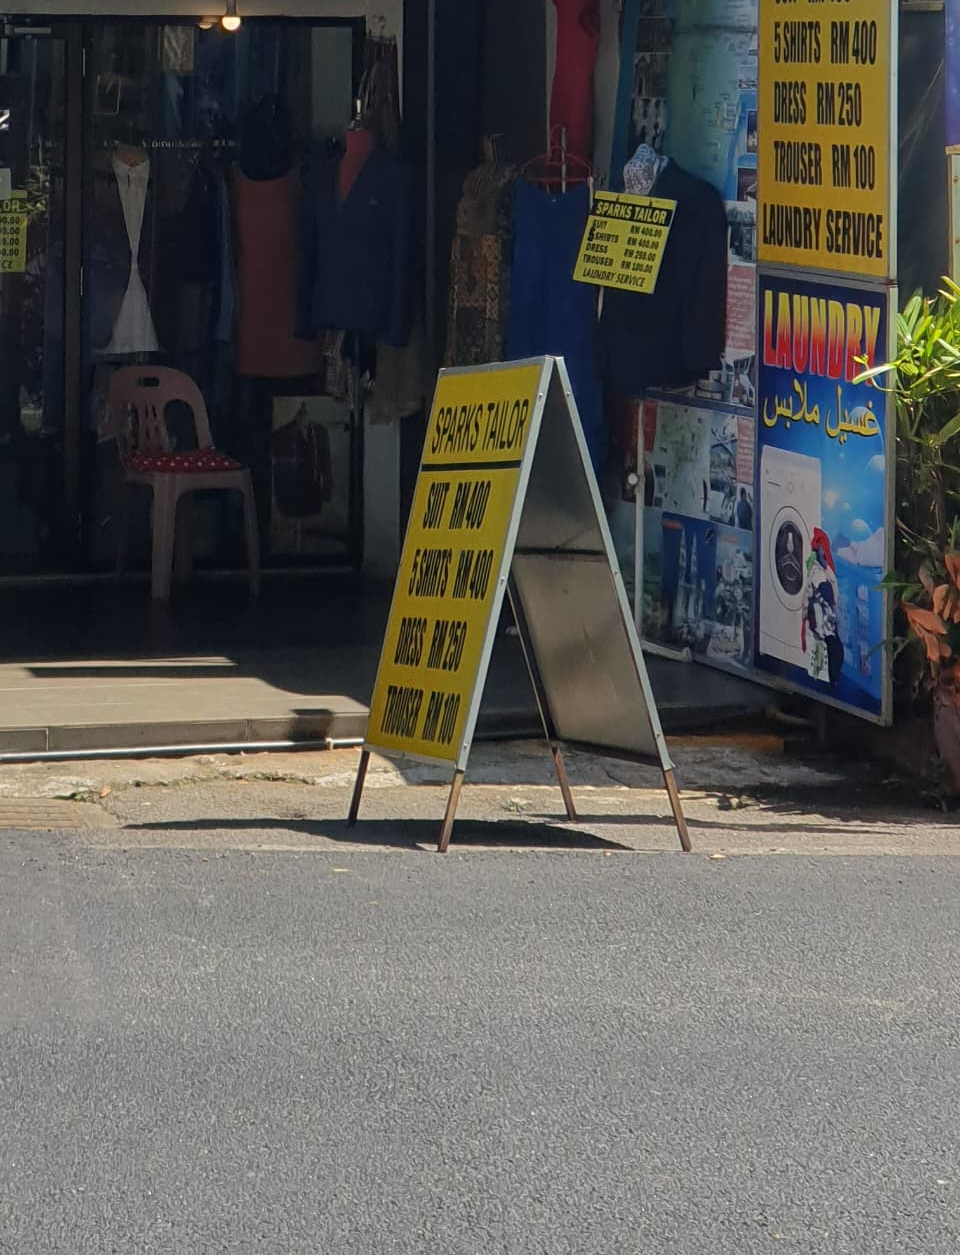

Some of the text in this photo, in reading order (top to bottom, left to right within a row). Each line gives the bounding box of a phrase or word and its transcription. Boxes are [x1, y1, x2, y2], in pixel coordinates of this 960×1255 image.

[774, 20, 877, 65] 5 SHIRTS RM 400
[773, 80, 862, 127] DRESS RM 250
[773, 140, 876, 191] TROUSER RM 100
[594, 232, 619, 244] SHIRTS
[596, 201, 668, 225] SPARKS TAILOR
[763, 203, 883, 259] LAUNDRY SERVICE
[583, 254, 615, 267] TROUSER
[585, 243, 609, 254] DRESS
[582, 267, 646, 288] LAUNDRY SERVICE
[763, 289, 881, 387] LAUNDRY
[431, 398, 529, 455] SPARKS TAILOR
[762, 377, 880, 445] غسيل ملابس
[422, 479, 492, 530] SUIT RM 400
[408, 548, 494, 601] 5 SHIRTS RM 400
[393, 617, 467, 672] DRESS RM 250
[380, 685, 461, 745] TROUSER RM 100
